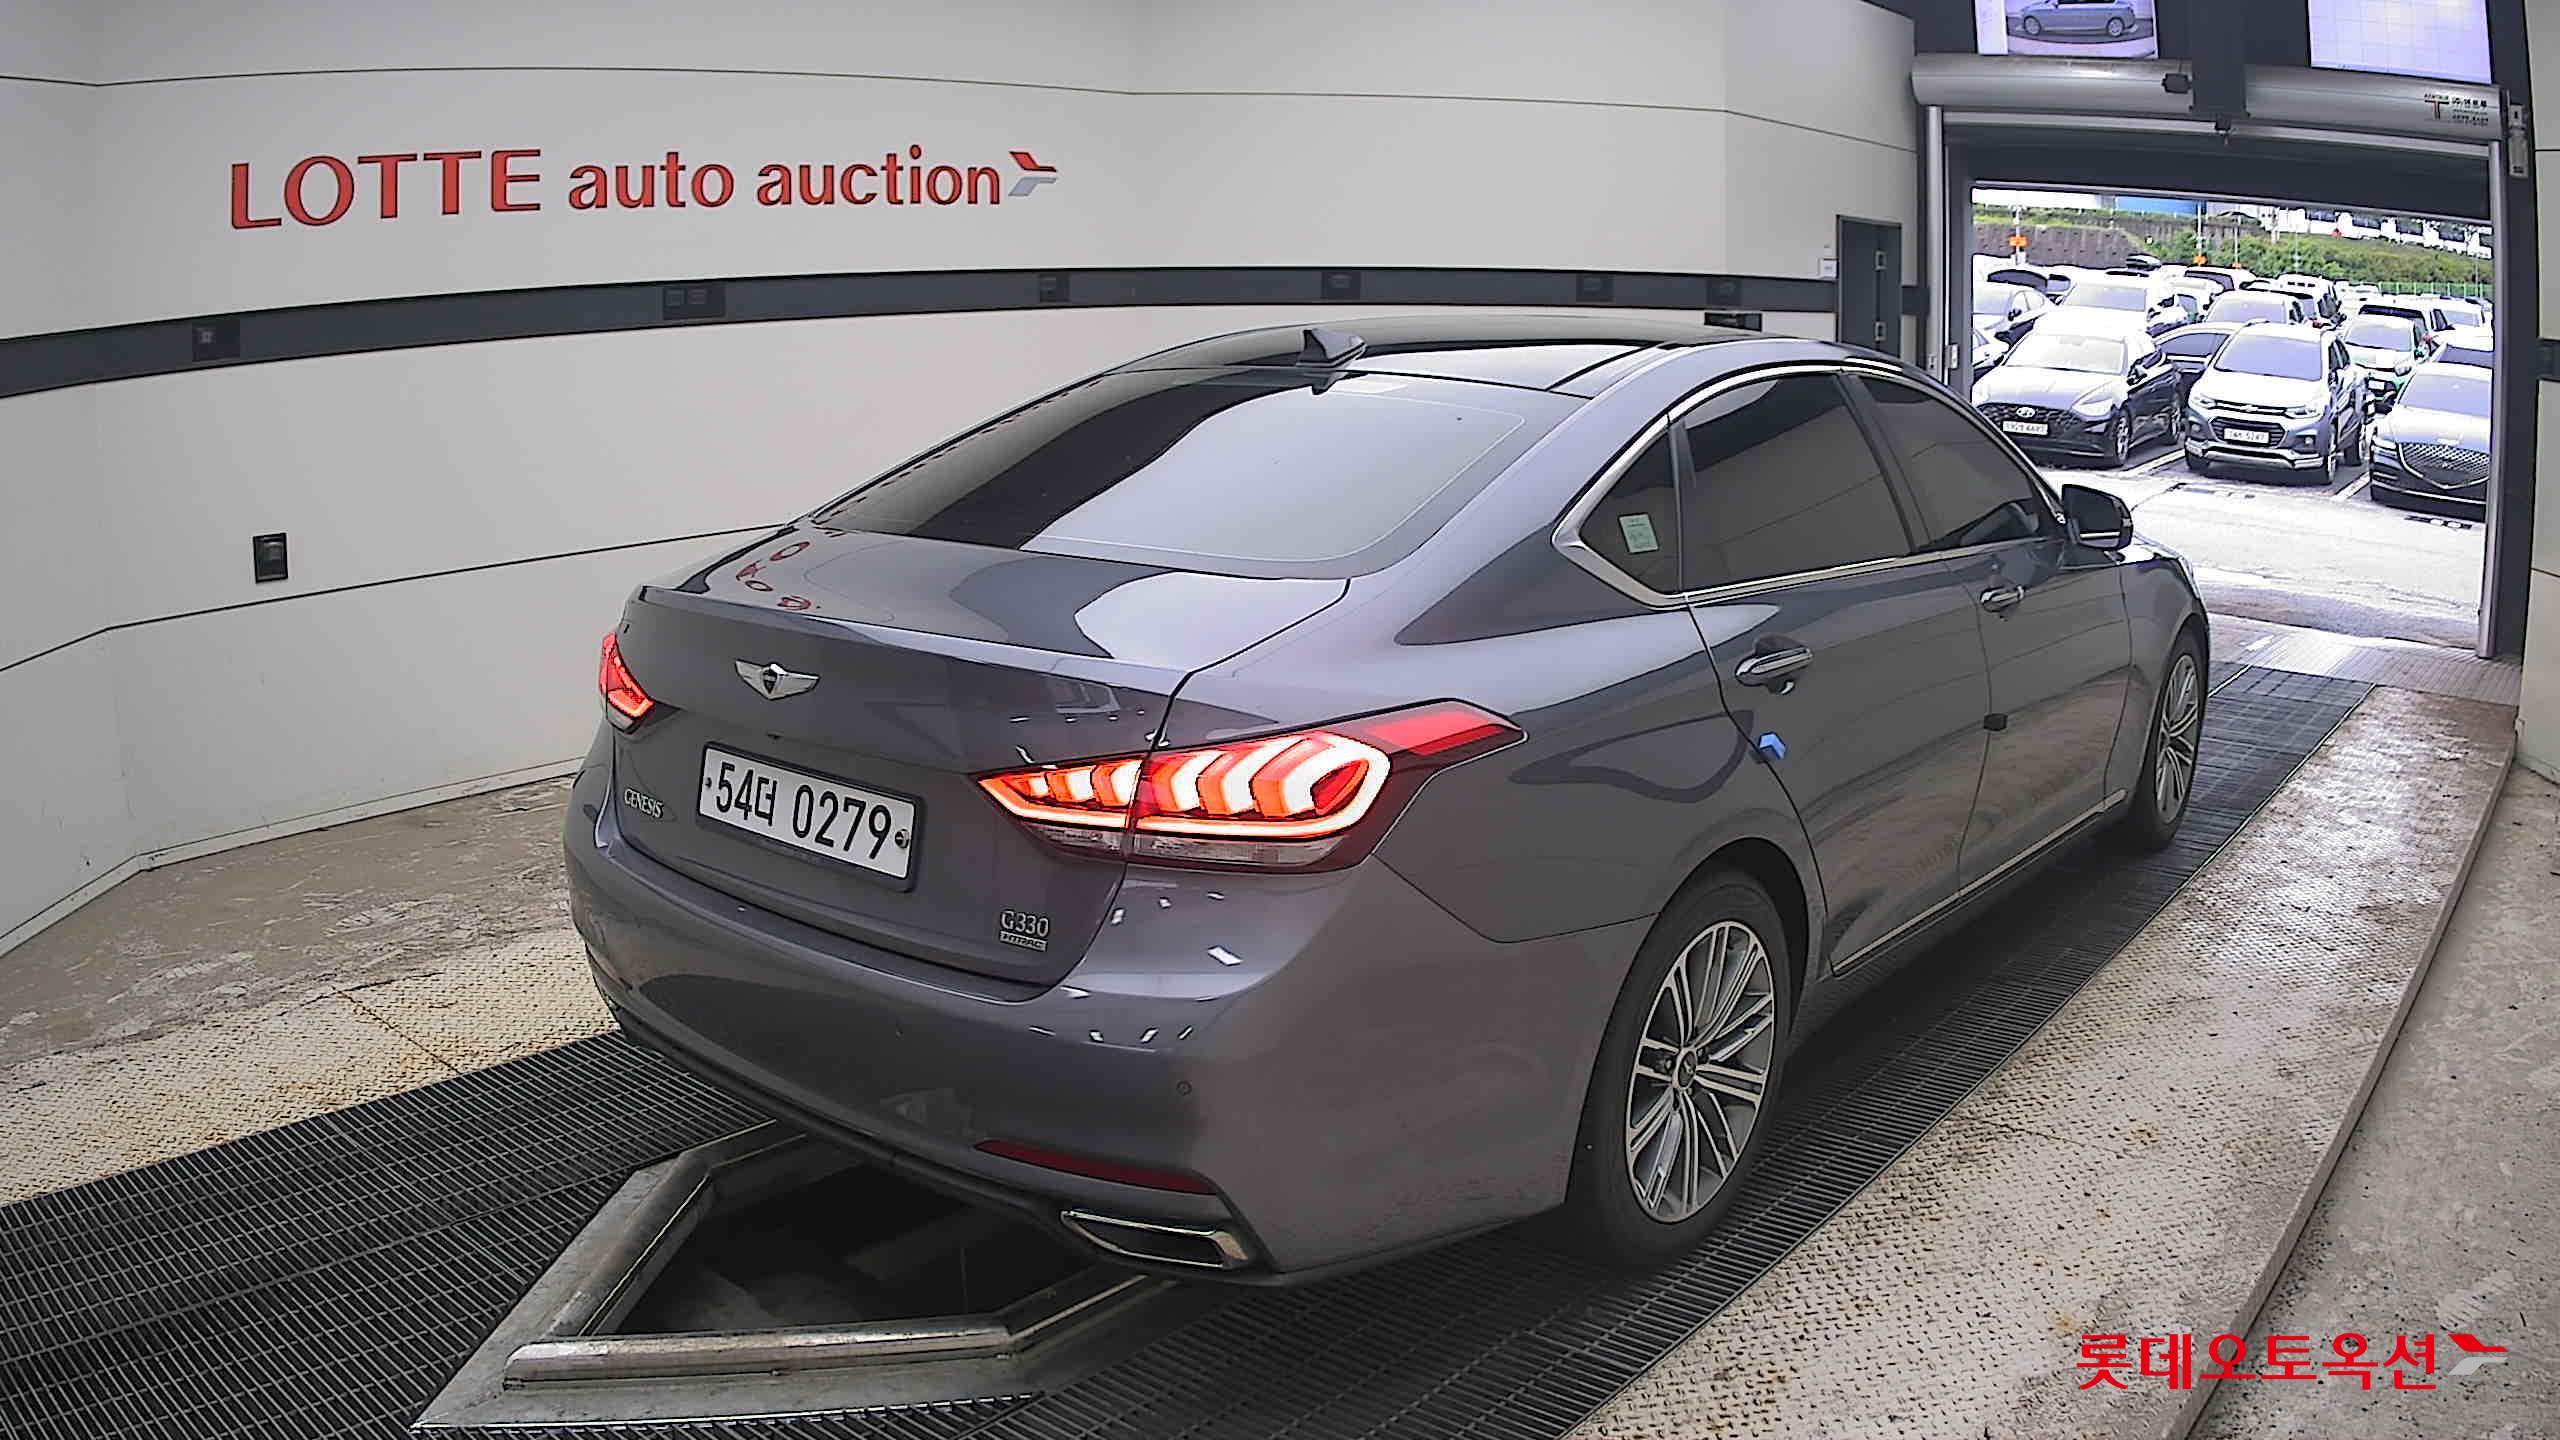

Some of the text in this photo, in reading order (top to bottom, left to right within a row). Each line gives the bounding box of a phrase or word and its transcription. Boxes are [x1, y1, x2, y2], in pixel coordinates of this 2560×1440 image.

[231, 144, 1000, 229] LOTTE auto auction
[624, 788, 664, 818] GENESIS
[715, 761, 892, 861] 54더 0279
[1001, 909, 1049, 937] G330
